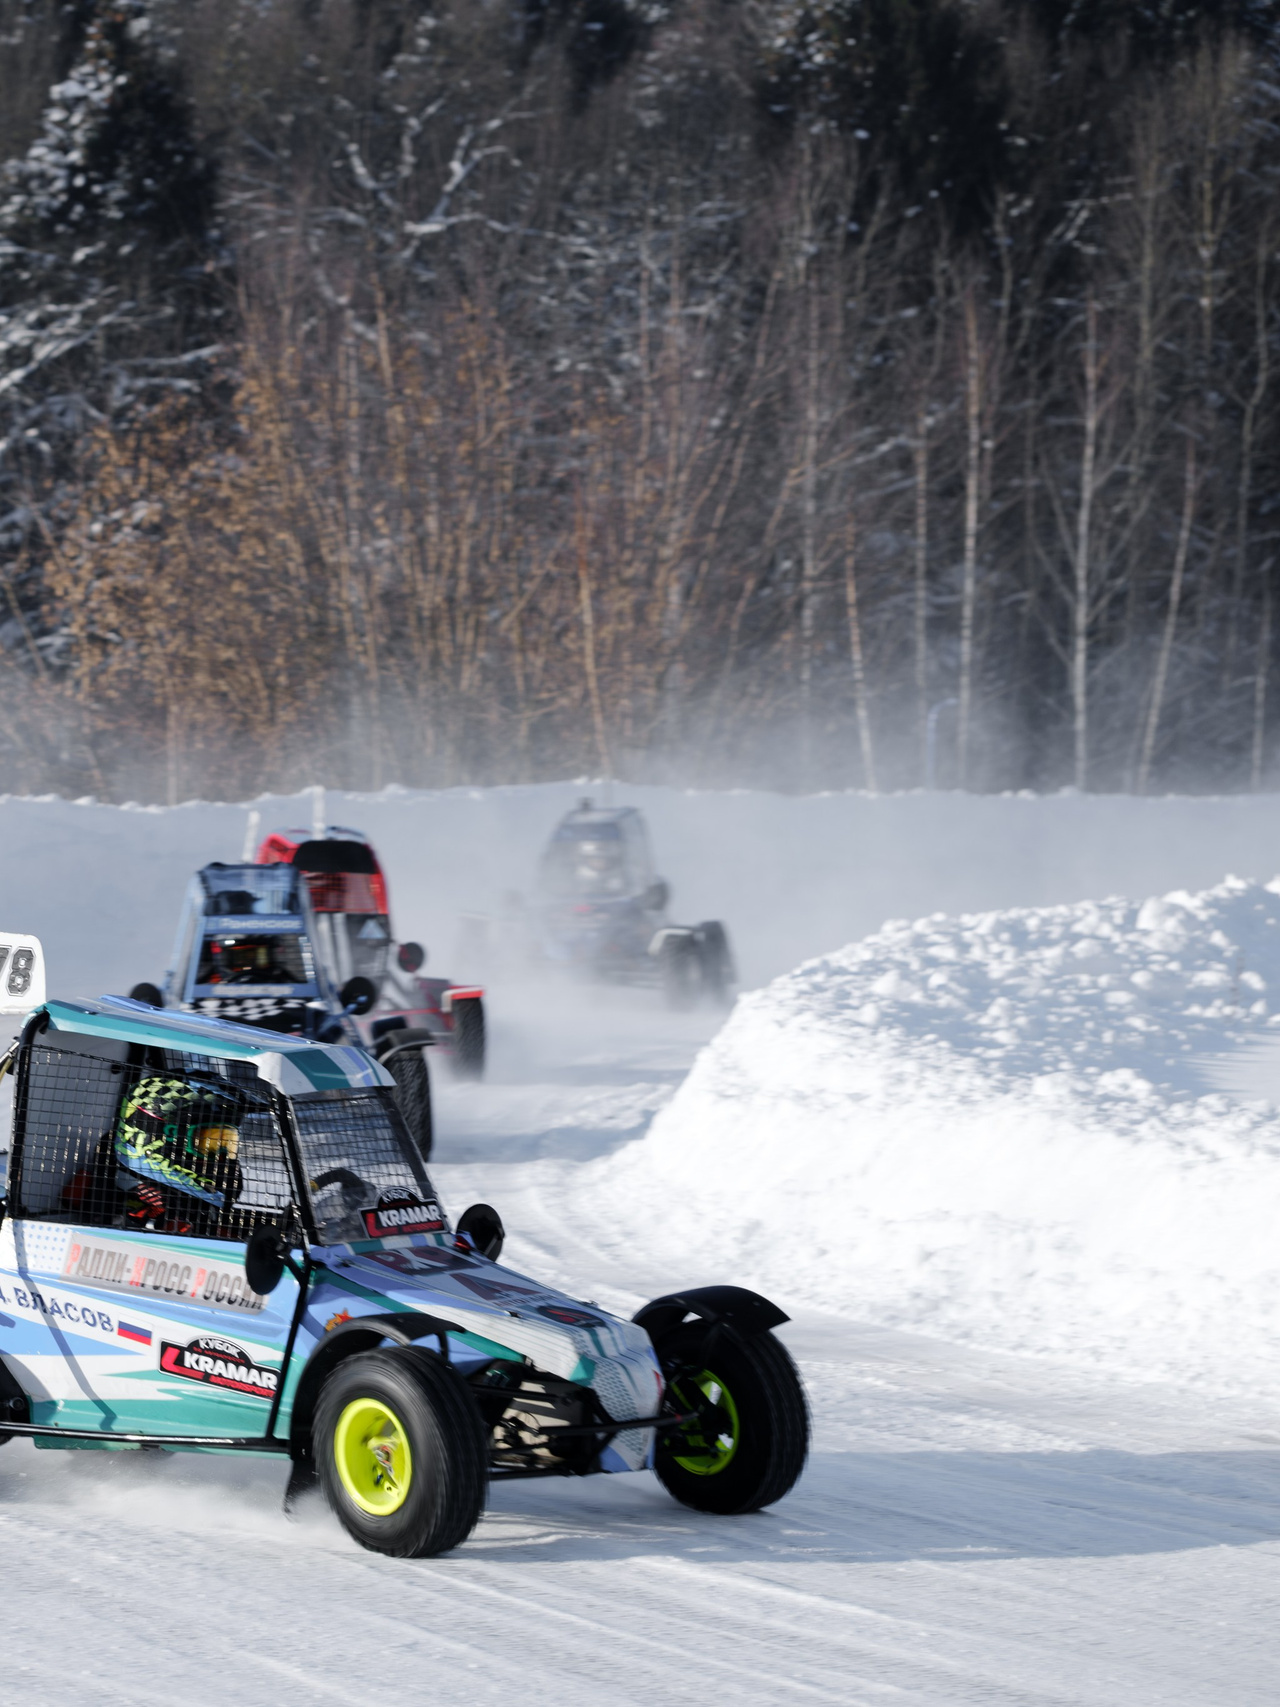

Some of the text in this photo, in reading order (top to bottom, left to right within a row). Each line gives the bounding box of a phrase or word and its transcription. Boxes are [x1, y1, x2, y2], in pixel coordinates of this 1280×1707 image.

[377, 1204, 442, 1227] KRAMAR
[13, 1287, 114, 1333] ВЛАСОВ
[198, 1338, 241, 1359] КУБОК
[183, 1350, 278, 1390] KRAMAR
